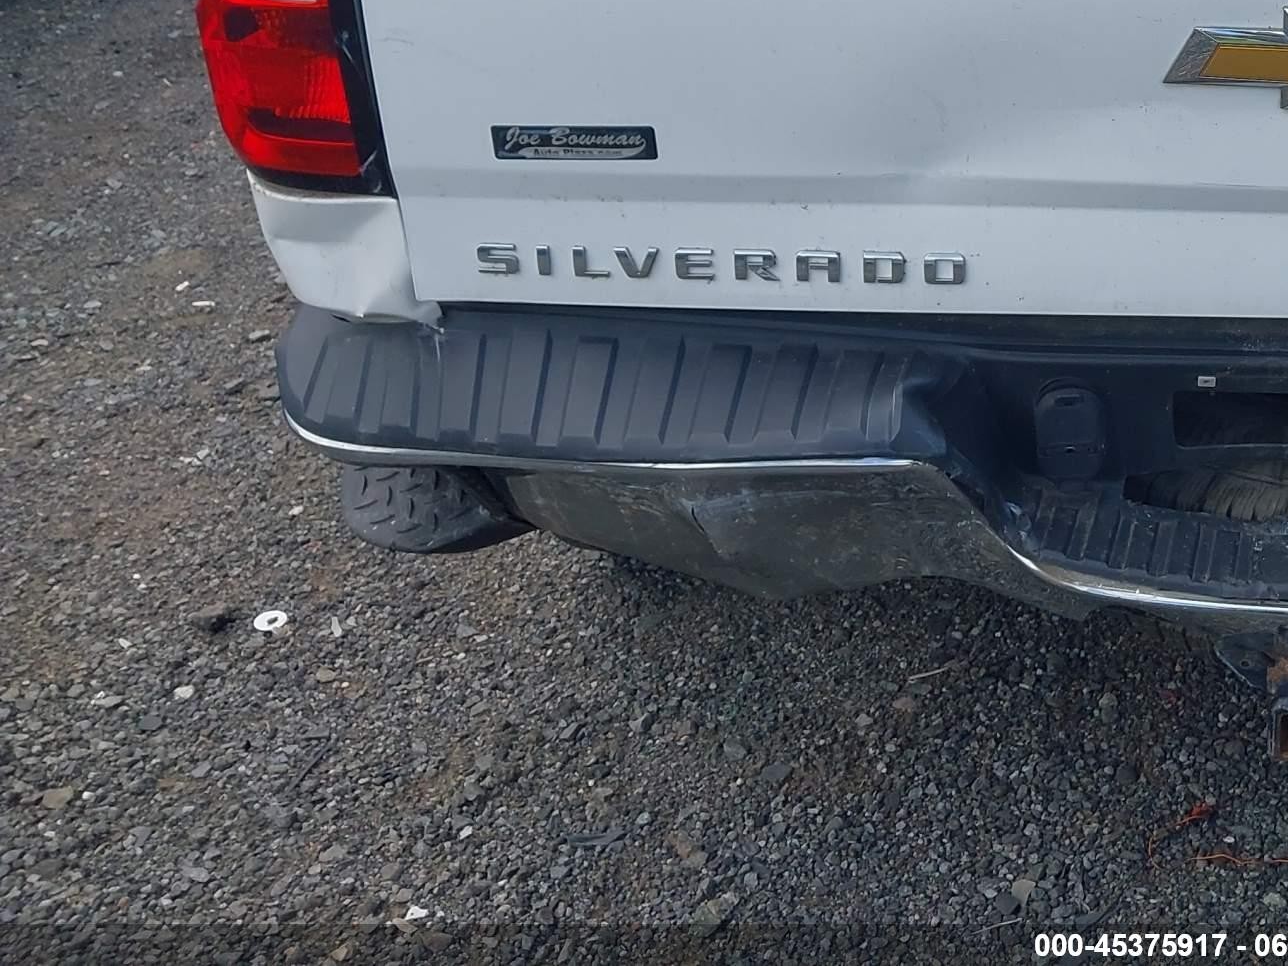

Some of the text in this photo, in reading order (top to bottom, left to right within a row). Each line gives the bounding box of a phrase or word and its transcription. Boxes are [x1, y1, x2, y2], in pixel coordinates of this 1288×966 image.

[504, 126, 644, 150] Joe Bowman
[477, 242, 966, 285] SILVERADO
